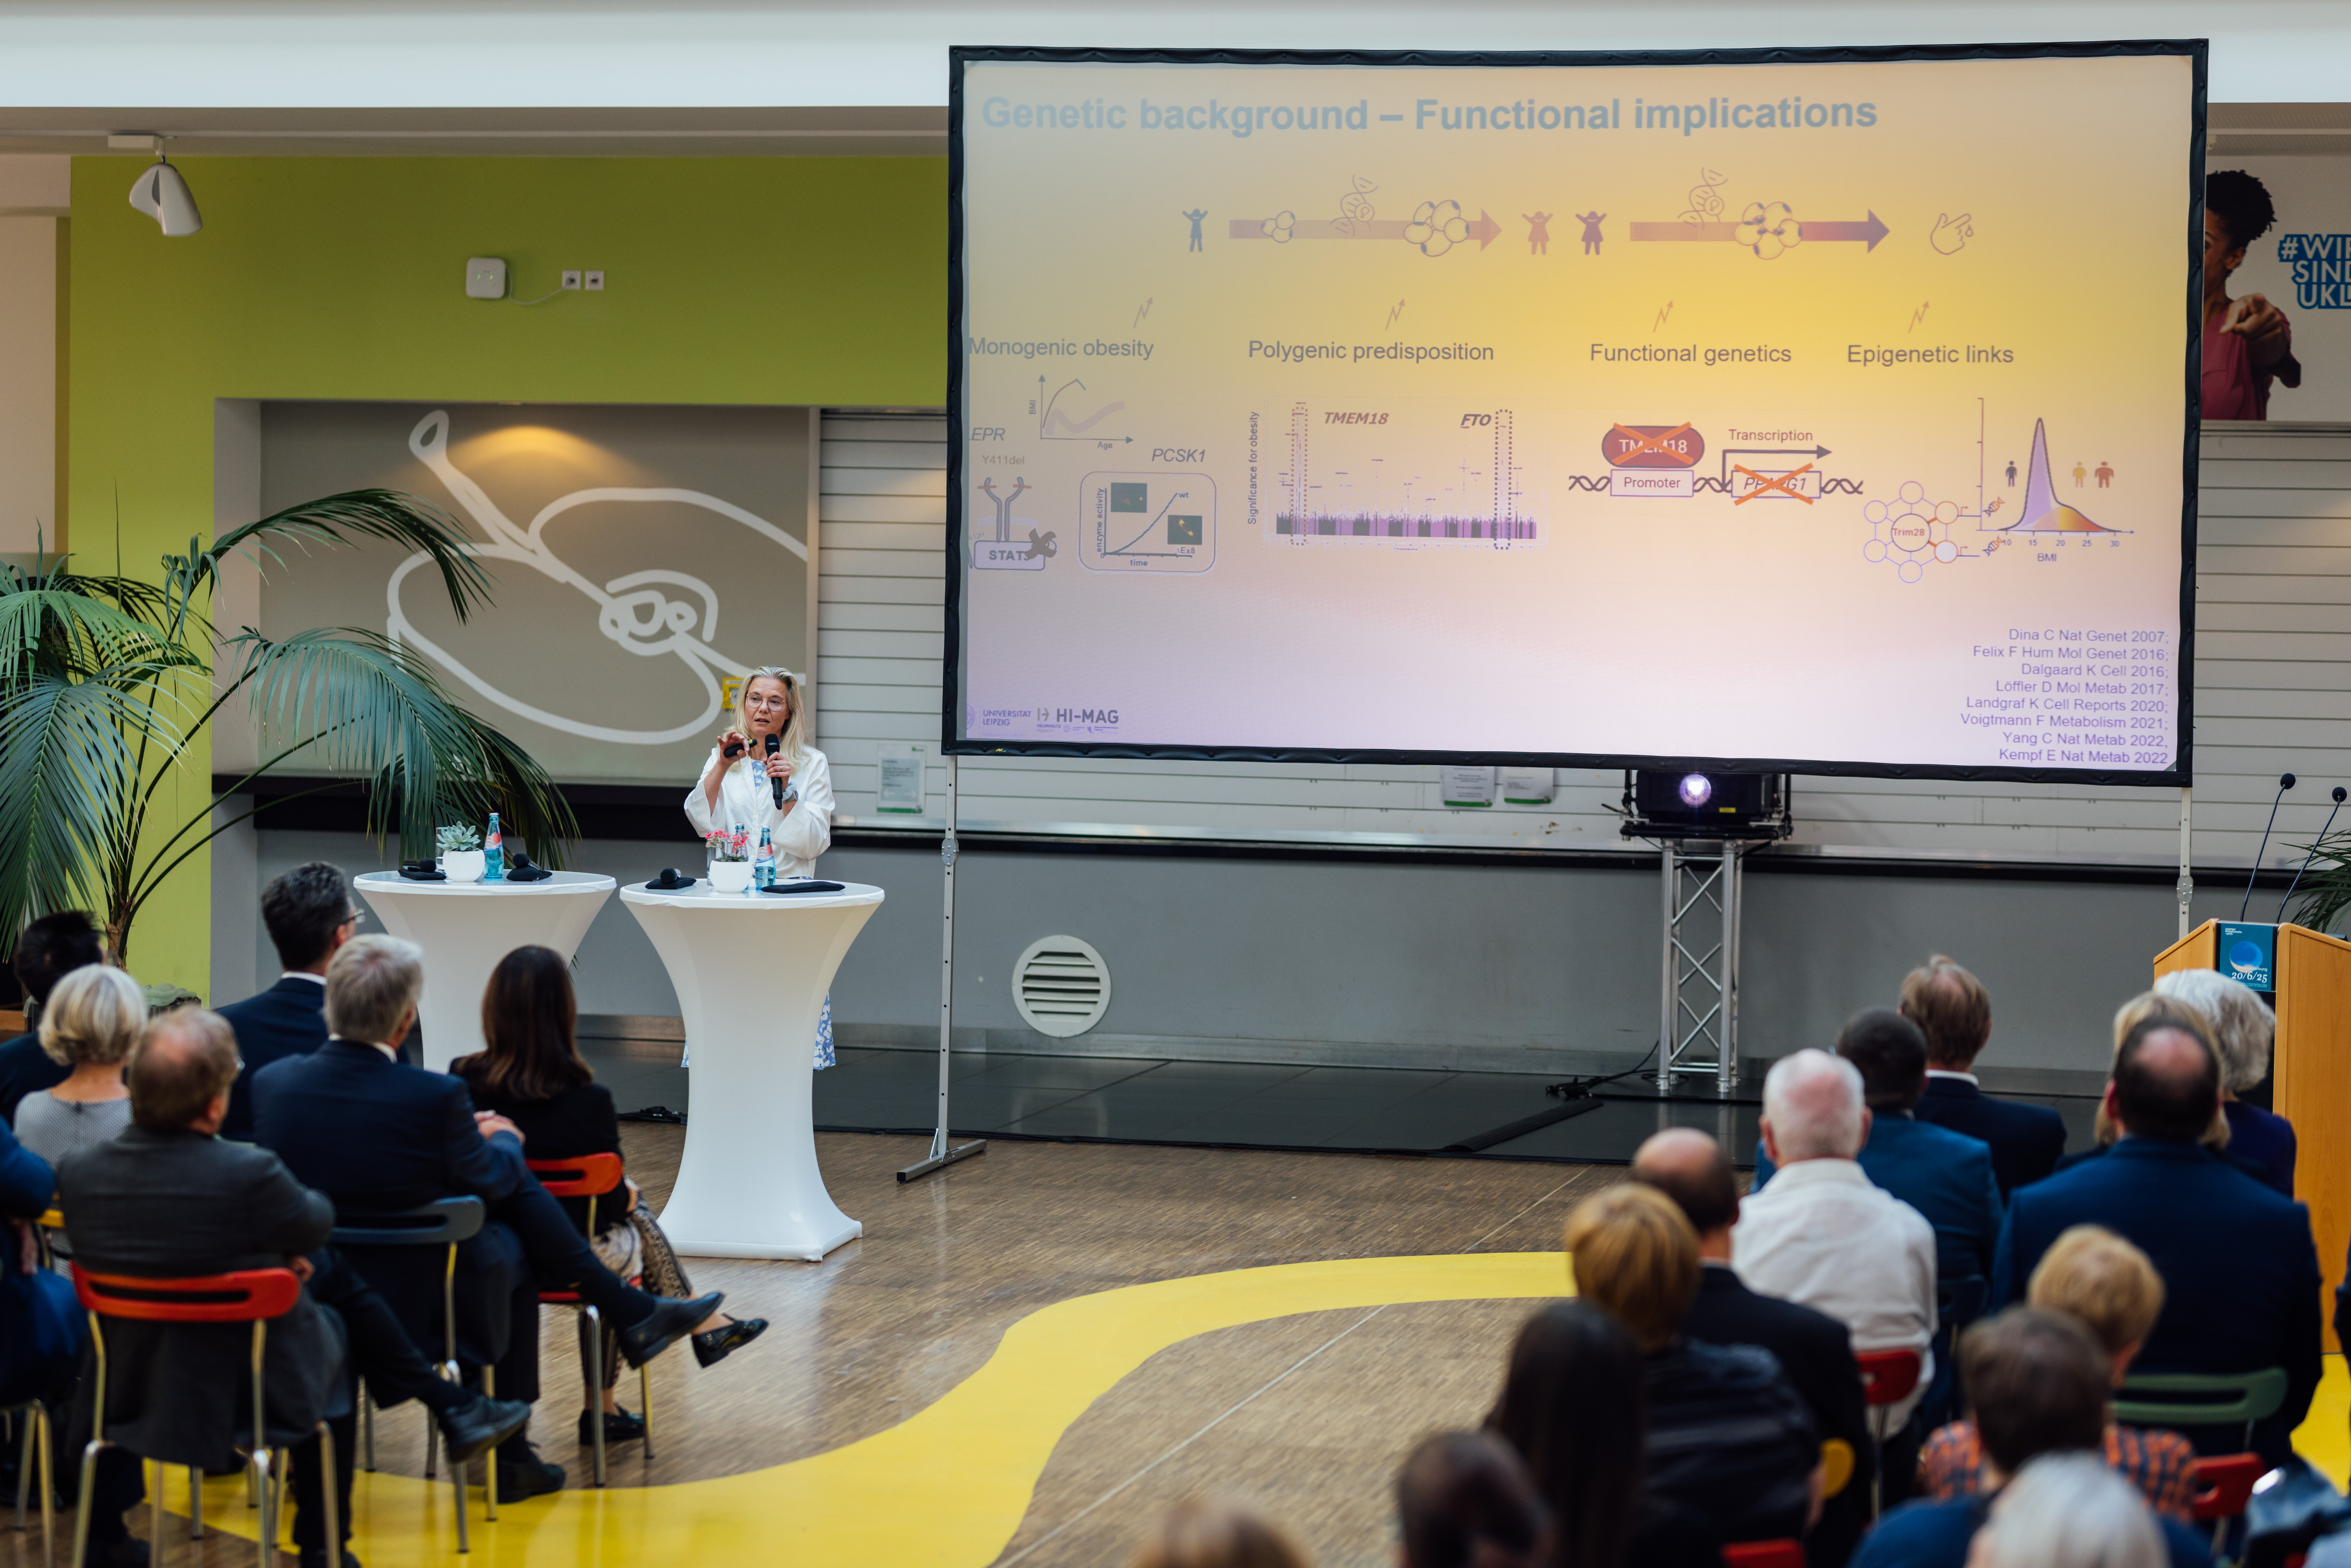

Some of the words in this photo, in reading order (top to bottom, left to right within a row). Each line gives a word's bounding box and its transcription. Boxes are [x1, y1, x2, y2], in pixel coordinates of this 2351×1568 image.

[982, 96, 1127, 130] Genetic
[1140, 96, 1369, 137] background
[1416, 98, 1619, 130] Functional
[1635, 96, 1877, 136] implications
[969, 337, 1077, 360] Monogenic
[1083, 339, 1154, 361] obesity
[1249, 340, 1347, 363] Polygenic
[1353, 342, 1494, 364] predisposition
[1590, 343, 1697, 362] Functional
[1704, 344, 1792, 365] genetics
[1847, 344, 1960, 366] Epigenetic
[1966, 345, 2014, 363] links
[1324, 412, 1389, 425] TMEM18
[1461, 414, 1492, 427] FTO
[969, 427, 1005, 441] EPR
[1248, 411, 1260, 447] obesity
[1728, 429, 1813, 443] Transcription
[1098, 441, 1113, 450] Age
[1619, 440, 1687, 453] TM18
[982, 455, 1025, 465] Y411del
[1152, 448, 1206, 463] PCSK1
[1248, 449, 1257, 463] for
[1624, 477, 1681, 488] Promoter
[1744, 477, 1806, 490] PPG1
[1096, 488, 1105, 518] activity
[1248, 466, 1259, 525] Significance
[2037, 553, 2057, 561] BMI
[2009, 629, 2039, 640] Dina
[2044, 629, 2054, 640] C
[2059, 630, 2082, 641] Nat
[2087, 630, 2127, 642] Genet
[2132, 631, 2168, 644] 2007;
[1974, 646, 2005, 657] Felix
[2009, 646, 2018, 657] F
[2023, 646, 2053, 657] Hum
[2058, 647, 2081, 658] Mol
[2087, 648, 2127, 659] Genet
[2132, 648, 2168, 661] 2016;
[2022, 663, 2081, 677] Dalgaard
[2087, 665, 2096, 675] K
[2101, 665, 2126, 676] Cell
[2132, 666, 2168, 679] 2016;
[1997, 681, 2038, 692] Löffler
[2042, 681, 2052, 692] D
[2057, 682, 2080, 693] Mol
[2085, 683, 2126, 693] Metab
[2131, 683, 2168, 697] 2017;
[1967, 697, 2026, 711] Landgraf
[2030, 698, 2039, 709] K
[2044, 698, 2069, 710] Cell
[2074, 699, 2126, 712] Reports
[2131, 700, 2168, 713] 2020;
[1056, 708, 1119, 724] HI-MAG
[1961, 713, 2031, 727] Voigtmann
[2037, 715, 2045, 726] F
[2050, 715, 2126, 728] Metabolism
[2131, 717, 2168, 730] 2021;
[2003, 731, 2038, 746] Yang
[2042, 733, 2052, 744] C
[2058, 733, 2080, 744] Nat
[2085, 734, 2126, 745] Metab
[2000, 748, 2043, 762] Kempf
[2047, 750, 2056, 760] E
[2061, 750, 2084, 761] Nat
[2089, 751, 2130, 762] Metab
[2135, 752, 2168, 763] 2022
[2231, 971, 2268, 983] 20/6/25
